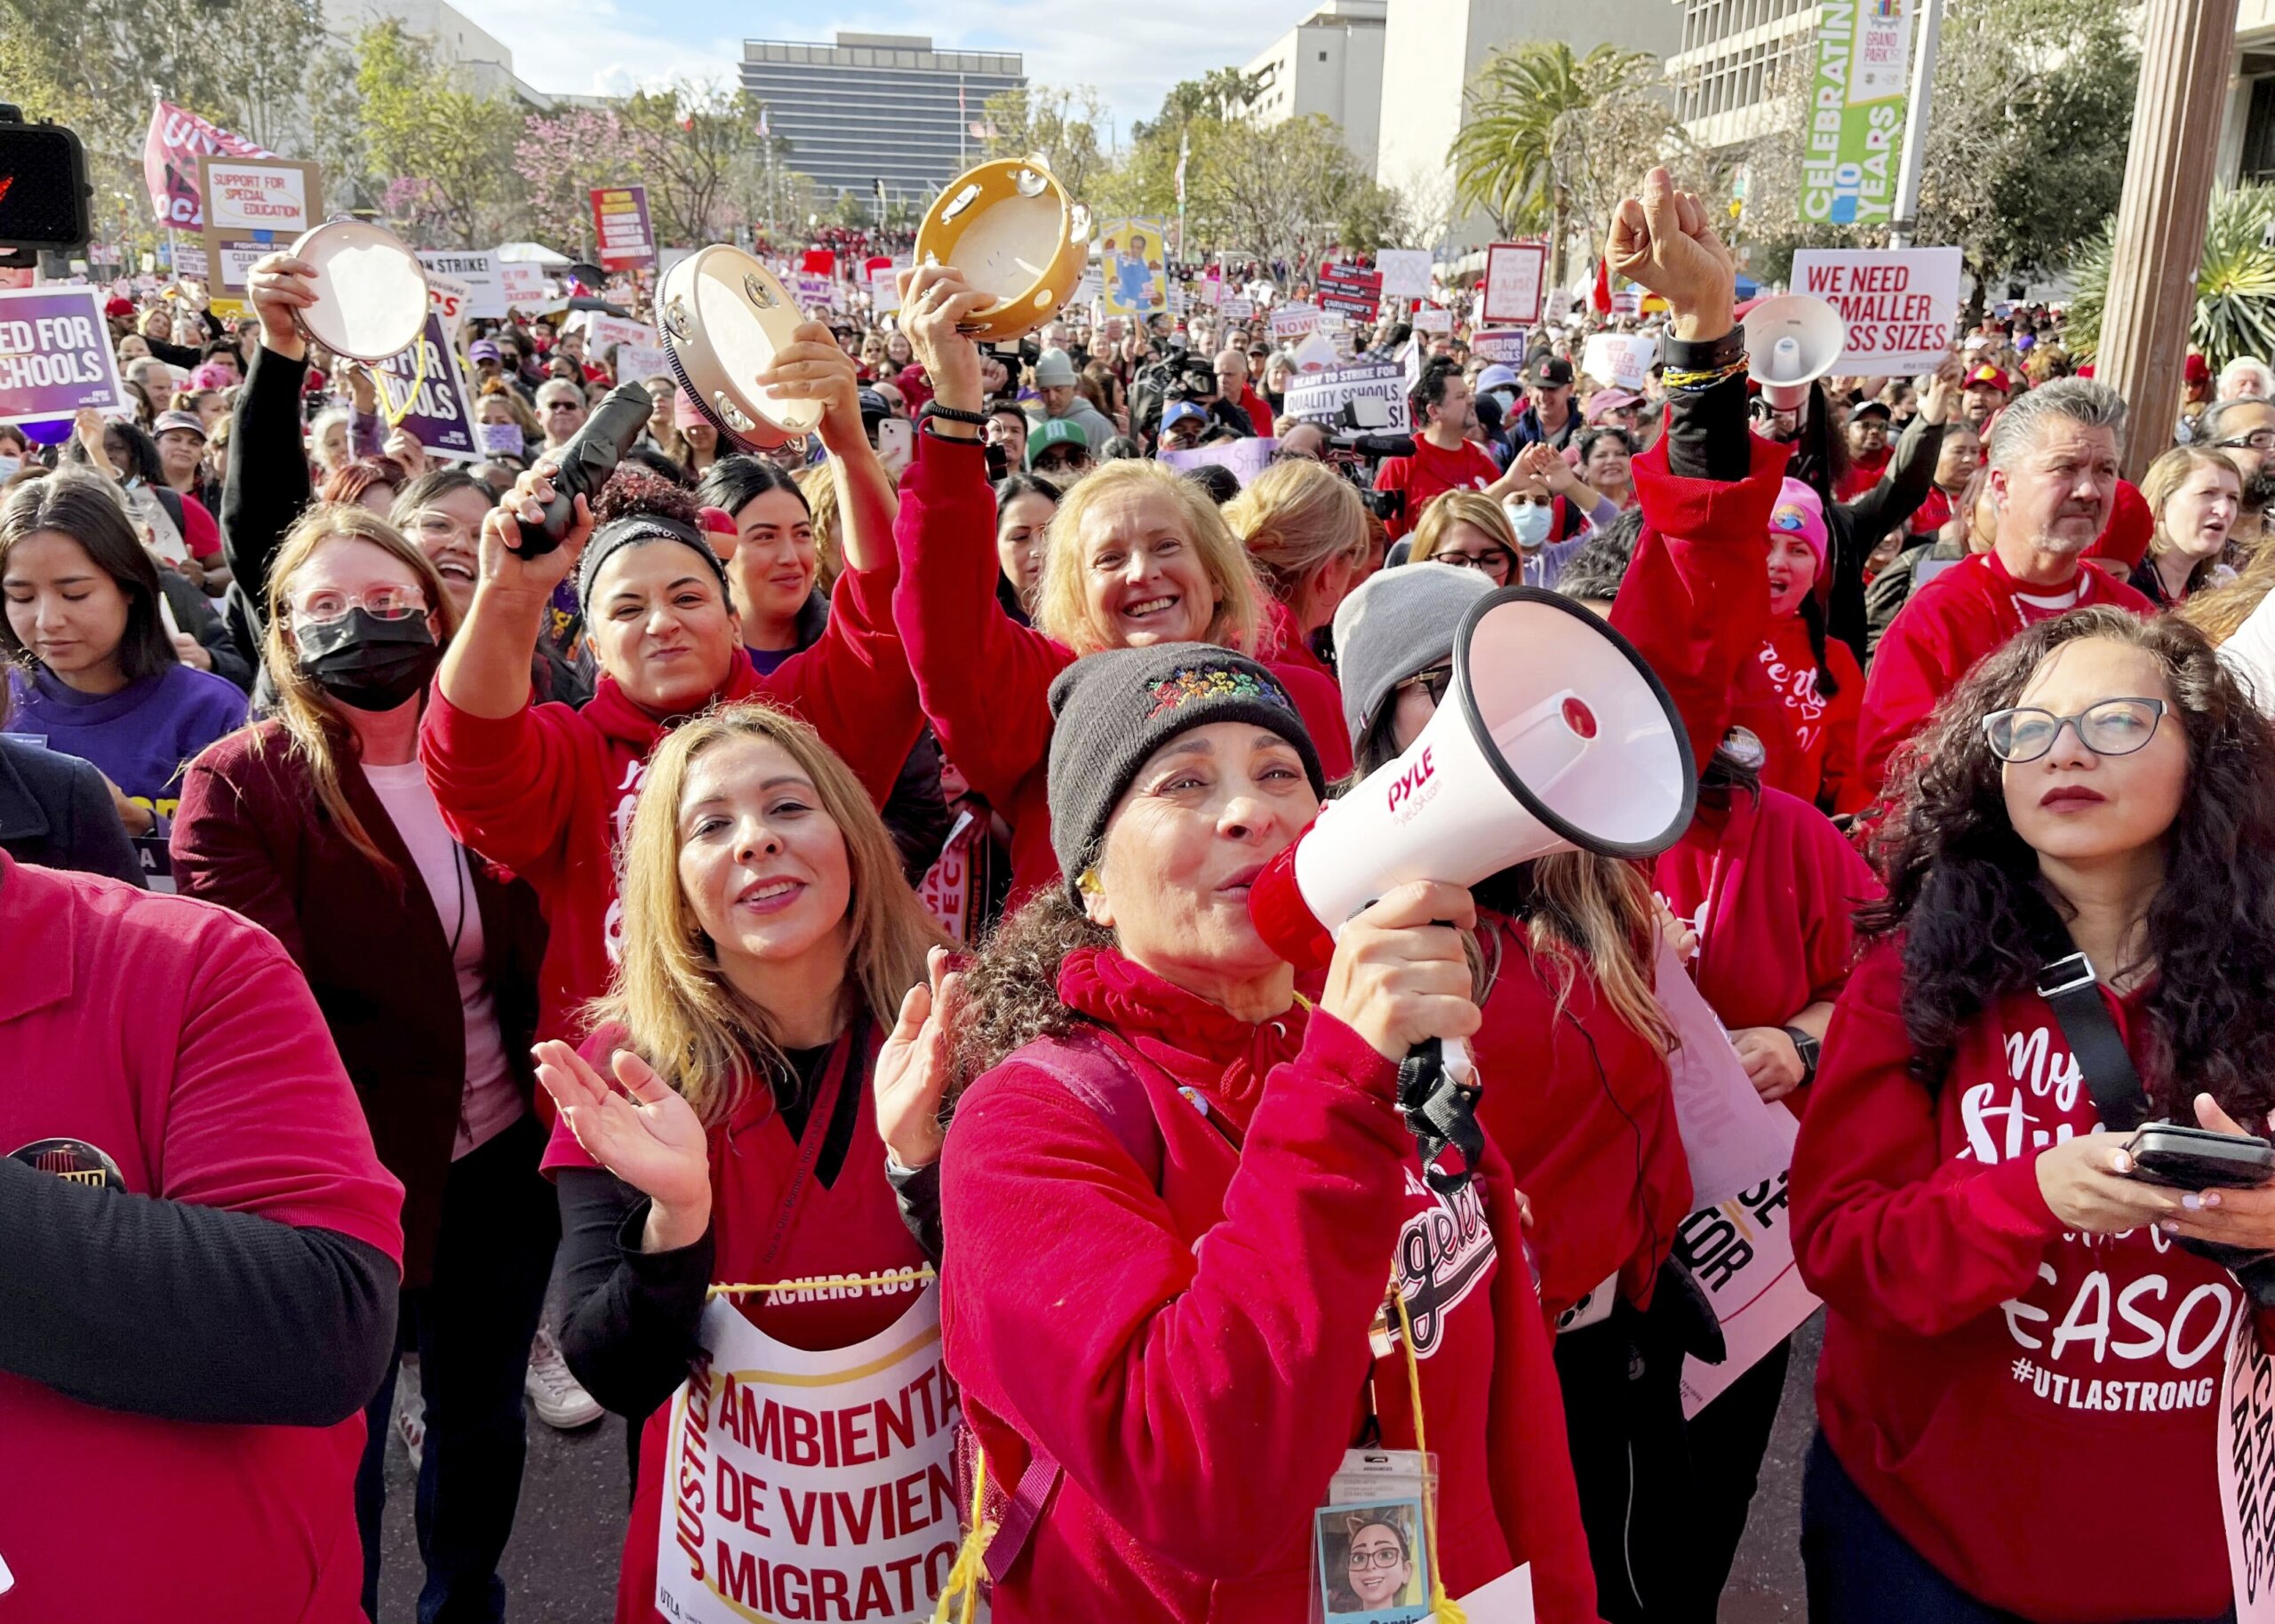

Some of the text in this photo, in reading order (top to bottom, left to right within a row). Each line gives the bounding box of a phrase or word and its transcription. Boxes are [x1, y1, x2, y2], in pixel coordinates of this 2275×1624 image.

[1865, 31, 1897, 47] GRAND
[1864, 48, 1888, 62] PARK
[1804, 0, 1854, 219] CELEBRATIN
[1856, 106, 1903, 219] YEARS
[213, 173, 285, 188] SUPPORT FOR
[1832, 163, 1863, 201] 10
[225, 188, 267, 202] SPECIAL
[243, 203, 301, 218] EDUCATION
[437, 258, 489, 273] STRIKE!
[1808, 266, 1909, 292] WE NEED
[36, 316, 96, 352] FOR
[1275, 317, 1319, 336] NOW!
[1882, 323, 1946, 352] SIZES
[1504, 338, 1522, 350] FOR
[1293, 365, 1397, 389] READY TO STRIKE FOR
[1289, 389, 1336, 413] QUALITY
[1388, 744, 1435, 813] PYLE
[2002, 1027, 2083, 1111] My
[870, 1265, 914, 1297] LOS
[2011, 1357, 2214, 1412] #UTLASTRONG
[716, 1454, 770, 1539] DE
[659, 1586, 681, 1620] UTLA
